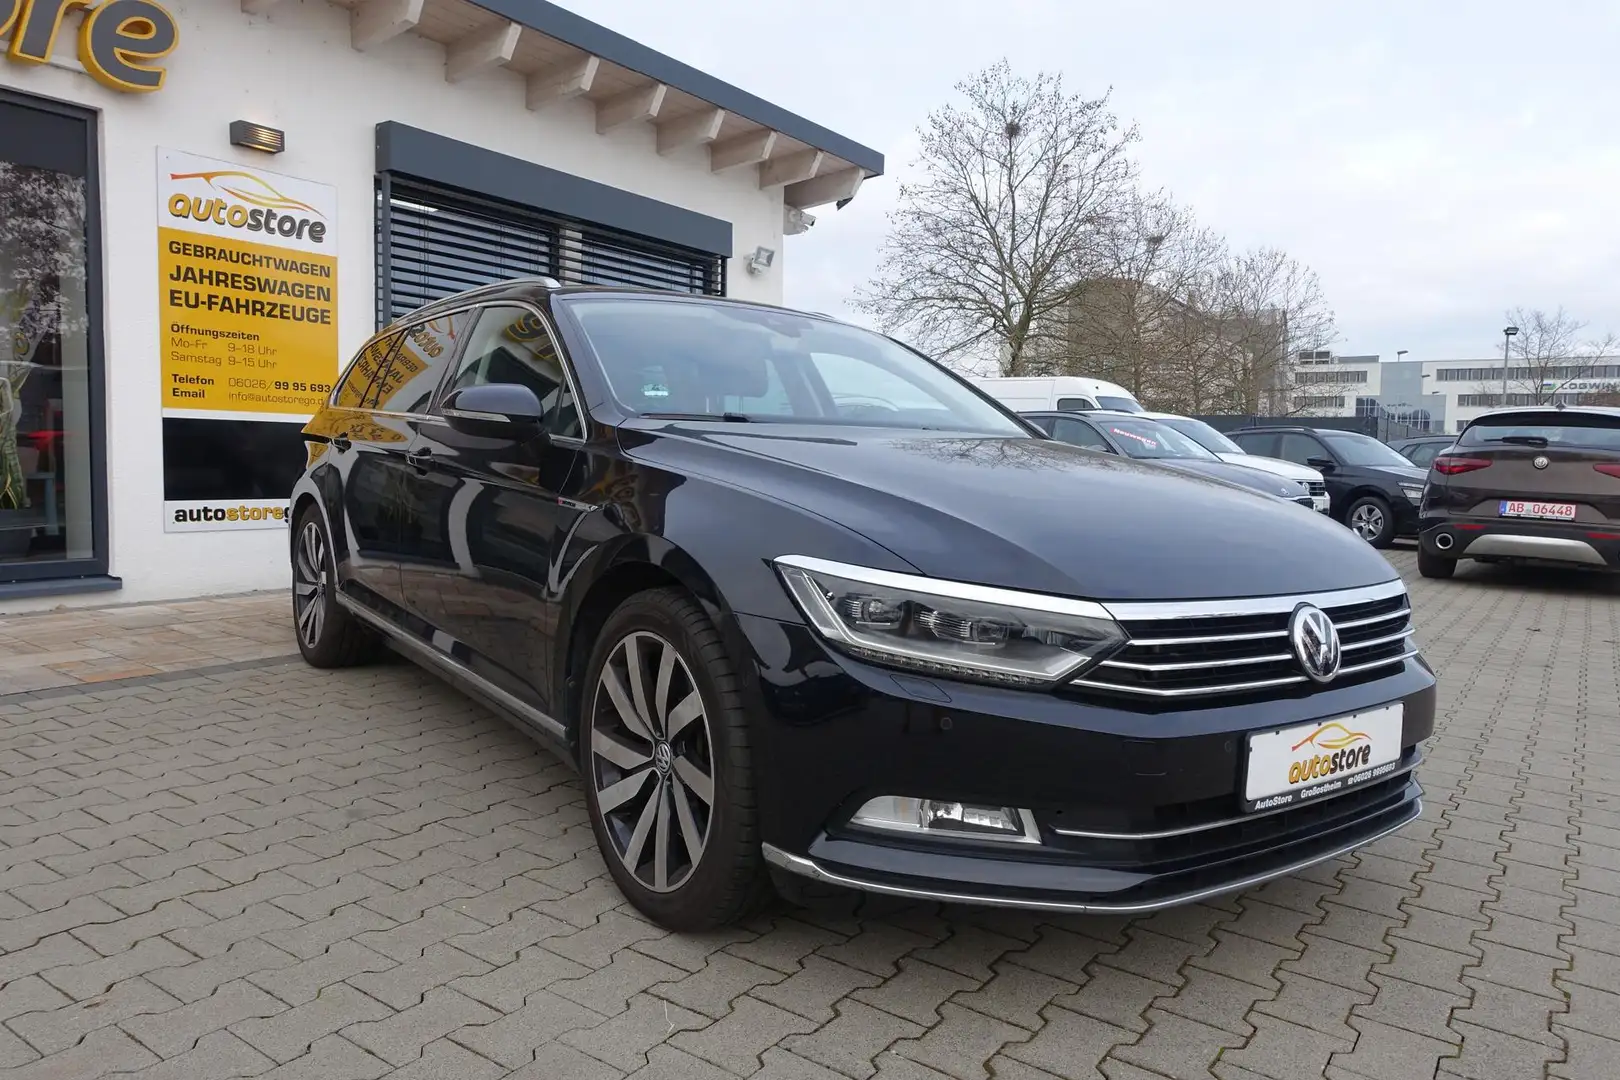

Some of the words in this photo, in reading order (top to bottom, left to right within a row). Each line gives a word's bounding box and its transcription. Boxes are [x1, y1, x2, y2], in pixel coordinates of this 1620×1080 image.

[0, 0, 179, 92] re
[168, 193, 327, 243] autostore
[168, 240, 331, 278] GEBRAUCHTWAGEN
[169, 264, 331, 302] JAHRESWAGEN
[169, 289, 331, 325] EU-FAHRZEUGE
[170, 321, 260, 341] Öffnungszeiten
[171, 351, 222, 367] Samstag
[258, 346, 277, 356] Uhr
[258, 359, 277, 369] Uhr
[172, 373, 215, 386] Telefon
[292, 381, 307, 392] 95
[310, 383, 331, 393] 693
[172, 387, 206, 399] Email
[1509, 503, 1524, 513] AB
[1532, 504, 1573, 516] 06448
[1288, 744, 1371, 785] autostore
[1254, 794, 1293, 811] AutoStore
